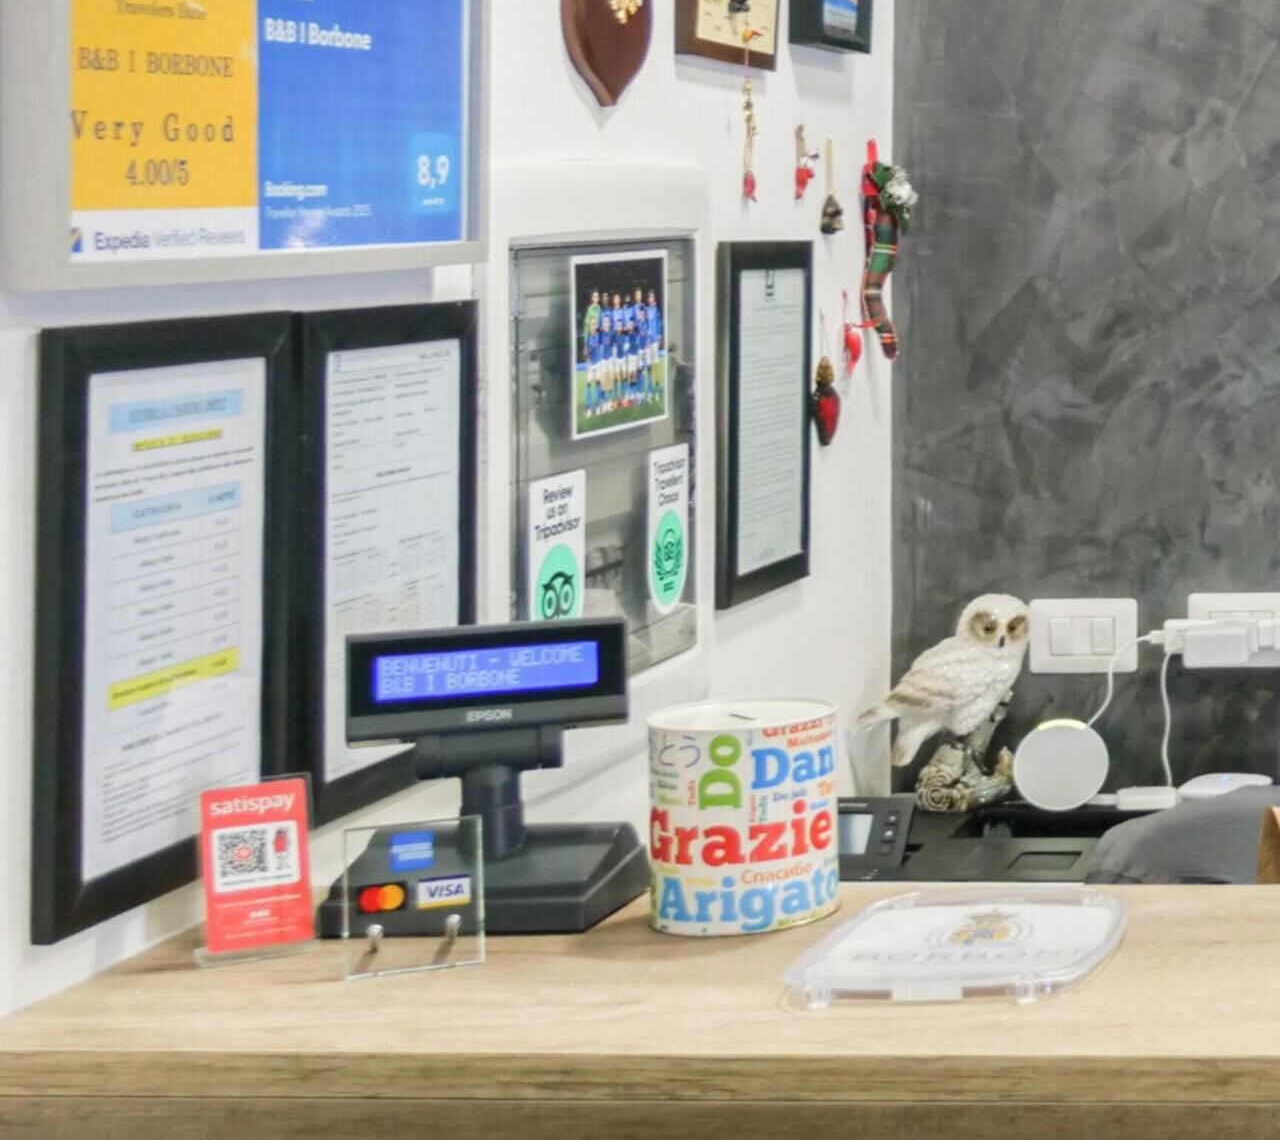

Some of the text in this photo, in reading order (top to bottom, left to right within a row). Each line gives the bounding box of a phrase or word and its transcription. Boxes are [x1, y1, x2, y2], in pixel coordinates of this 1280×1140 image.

[264, 18, 372, 50] B&B Borbone
[79, 46, 234, 78] B&B BORBONE
[70, 110, 235, 147] Very Good
[125, 159, 190, 186] 4.00/5
[417, 154, 450, 189] 8,9
[95, 231, 151, 254] Expedia
[543, 485, 574, 504] Review
[534, 517, 581, 542] Tripadvisor
[382, 646, 583, 676] BENVENUTI WELCOME
[449, 668, 521, 690] BORBONE
[467, 709, 512, 722] EPSON
[210, 792, 296, 815] satispay
[650, 799, 832, 866] Grazie
[741, 861, 813, 885] Спасибо
[426, 884, 464, 899] VISA
